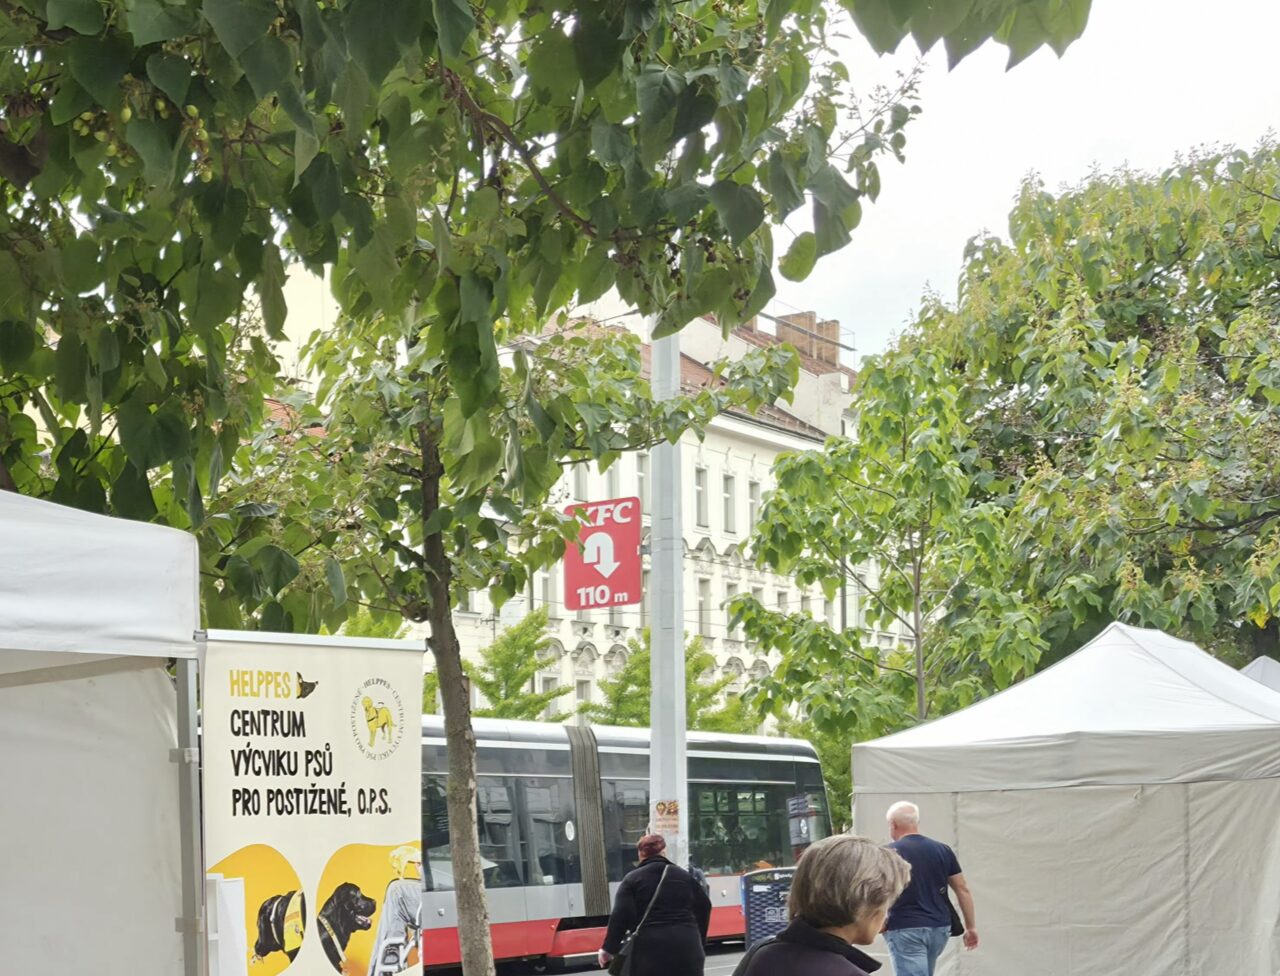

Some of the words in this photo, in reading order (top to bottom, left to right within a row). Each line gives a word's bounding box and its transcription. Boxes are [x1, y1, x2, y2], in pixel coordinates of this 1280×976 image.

[577, 585, 610, 606] 110
[614, 592, 628, 602] m
[230, 670, 291, 699] HELPPES
[230, 709, 306, 738] CENTRUM
[230, 741, 298, 776] VÝCVIKU
[305, 742, 333, 777] PSŮ
[232, 788, 261, 816] PRO
[267, 781, 351, 817] POSTIŽENÉ,
[358, 788, 391, 815] O.P.S.
